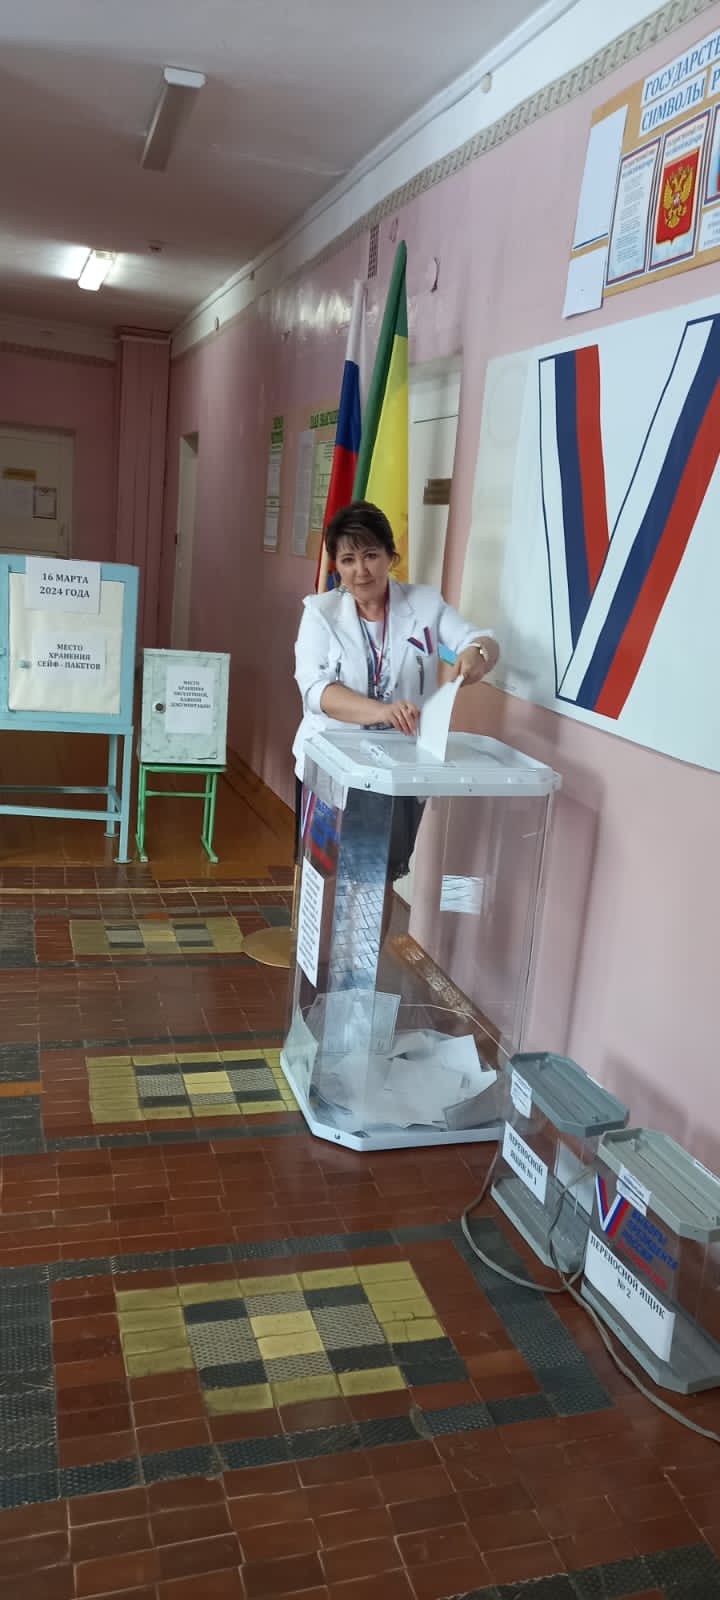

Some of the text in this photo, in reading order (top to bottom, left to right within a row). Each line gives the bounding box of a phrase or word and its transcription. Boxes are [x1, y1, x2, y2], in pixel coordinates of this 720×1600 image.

[642, 76, 706, 131] СИМВОЛЫ
[42, 572, 89, 584] 16 МАРТА
[40, 586, 90, 598] 2024 ГОДА
[57, 643, 83, 651] МЕСТО
[48, 652, 91, 661] ХРАНЕНИЯ
[37, 660, 59, 668] СЕЙФ
[508, 1131, 543, 1176] ПЕРЕНОСНОЙ
[590, 1234, 639, 1293] ПЕРЕНОСНОЙ
[638, 1287, 667, 1320] ЯЩИК
[616, 1277, 632, 1299] № 2
